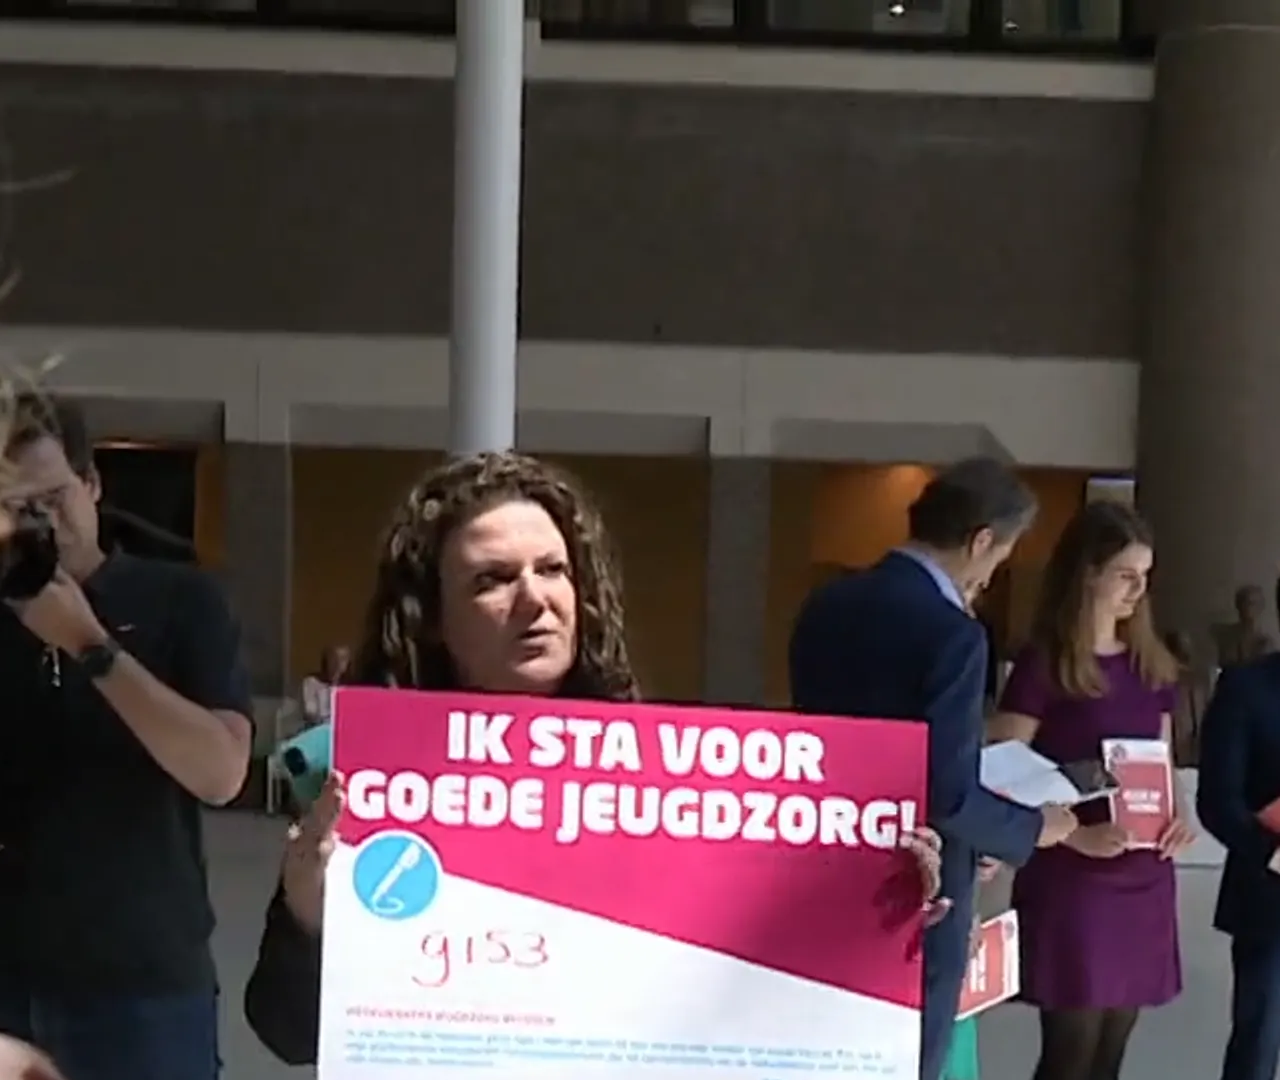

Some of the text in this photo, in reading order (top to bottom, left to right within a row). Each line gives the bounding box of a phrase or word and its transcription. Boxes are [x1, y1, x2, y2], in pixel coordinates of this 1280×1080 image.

[448, 711, 824, 782] IK STA VOOR
[347, 769, 918, 848] GOEDE JEUGDZORG!
